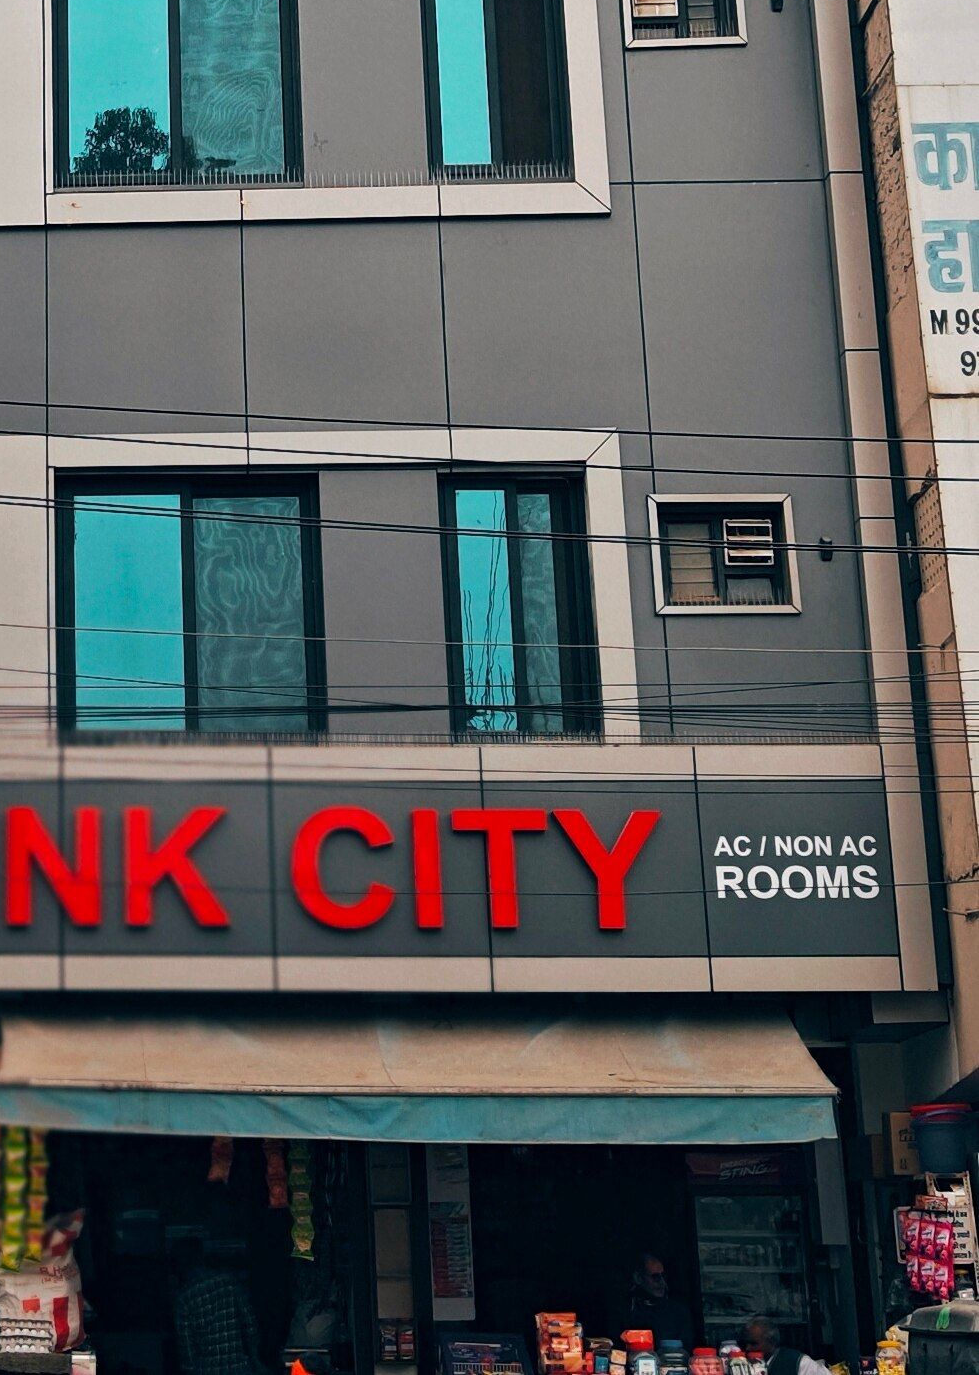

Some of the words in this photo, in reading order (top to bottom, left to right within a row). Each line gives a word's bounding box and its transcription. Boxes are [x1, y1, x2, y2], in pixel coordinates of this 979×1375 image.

[930, 309, 948, 335] M
[714, 835, 752, 857] AC
[759, 835, 767, 857] /
[774, 835, 833, 857] NON
[840, 835, 878, 857] AC
[290, 805, 662, 930] CITY
[715, 865, 880, 900] ROOMS
